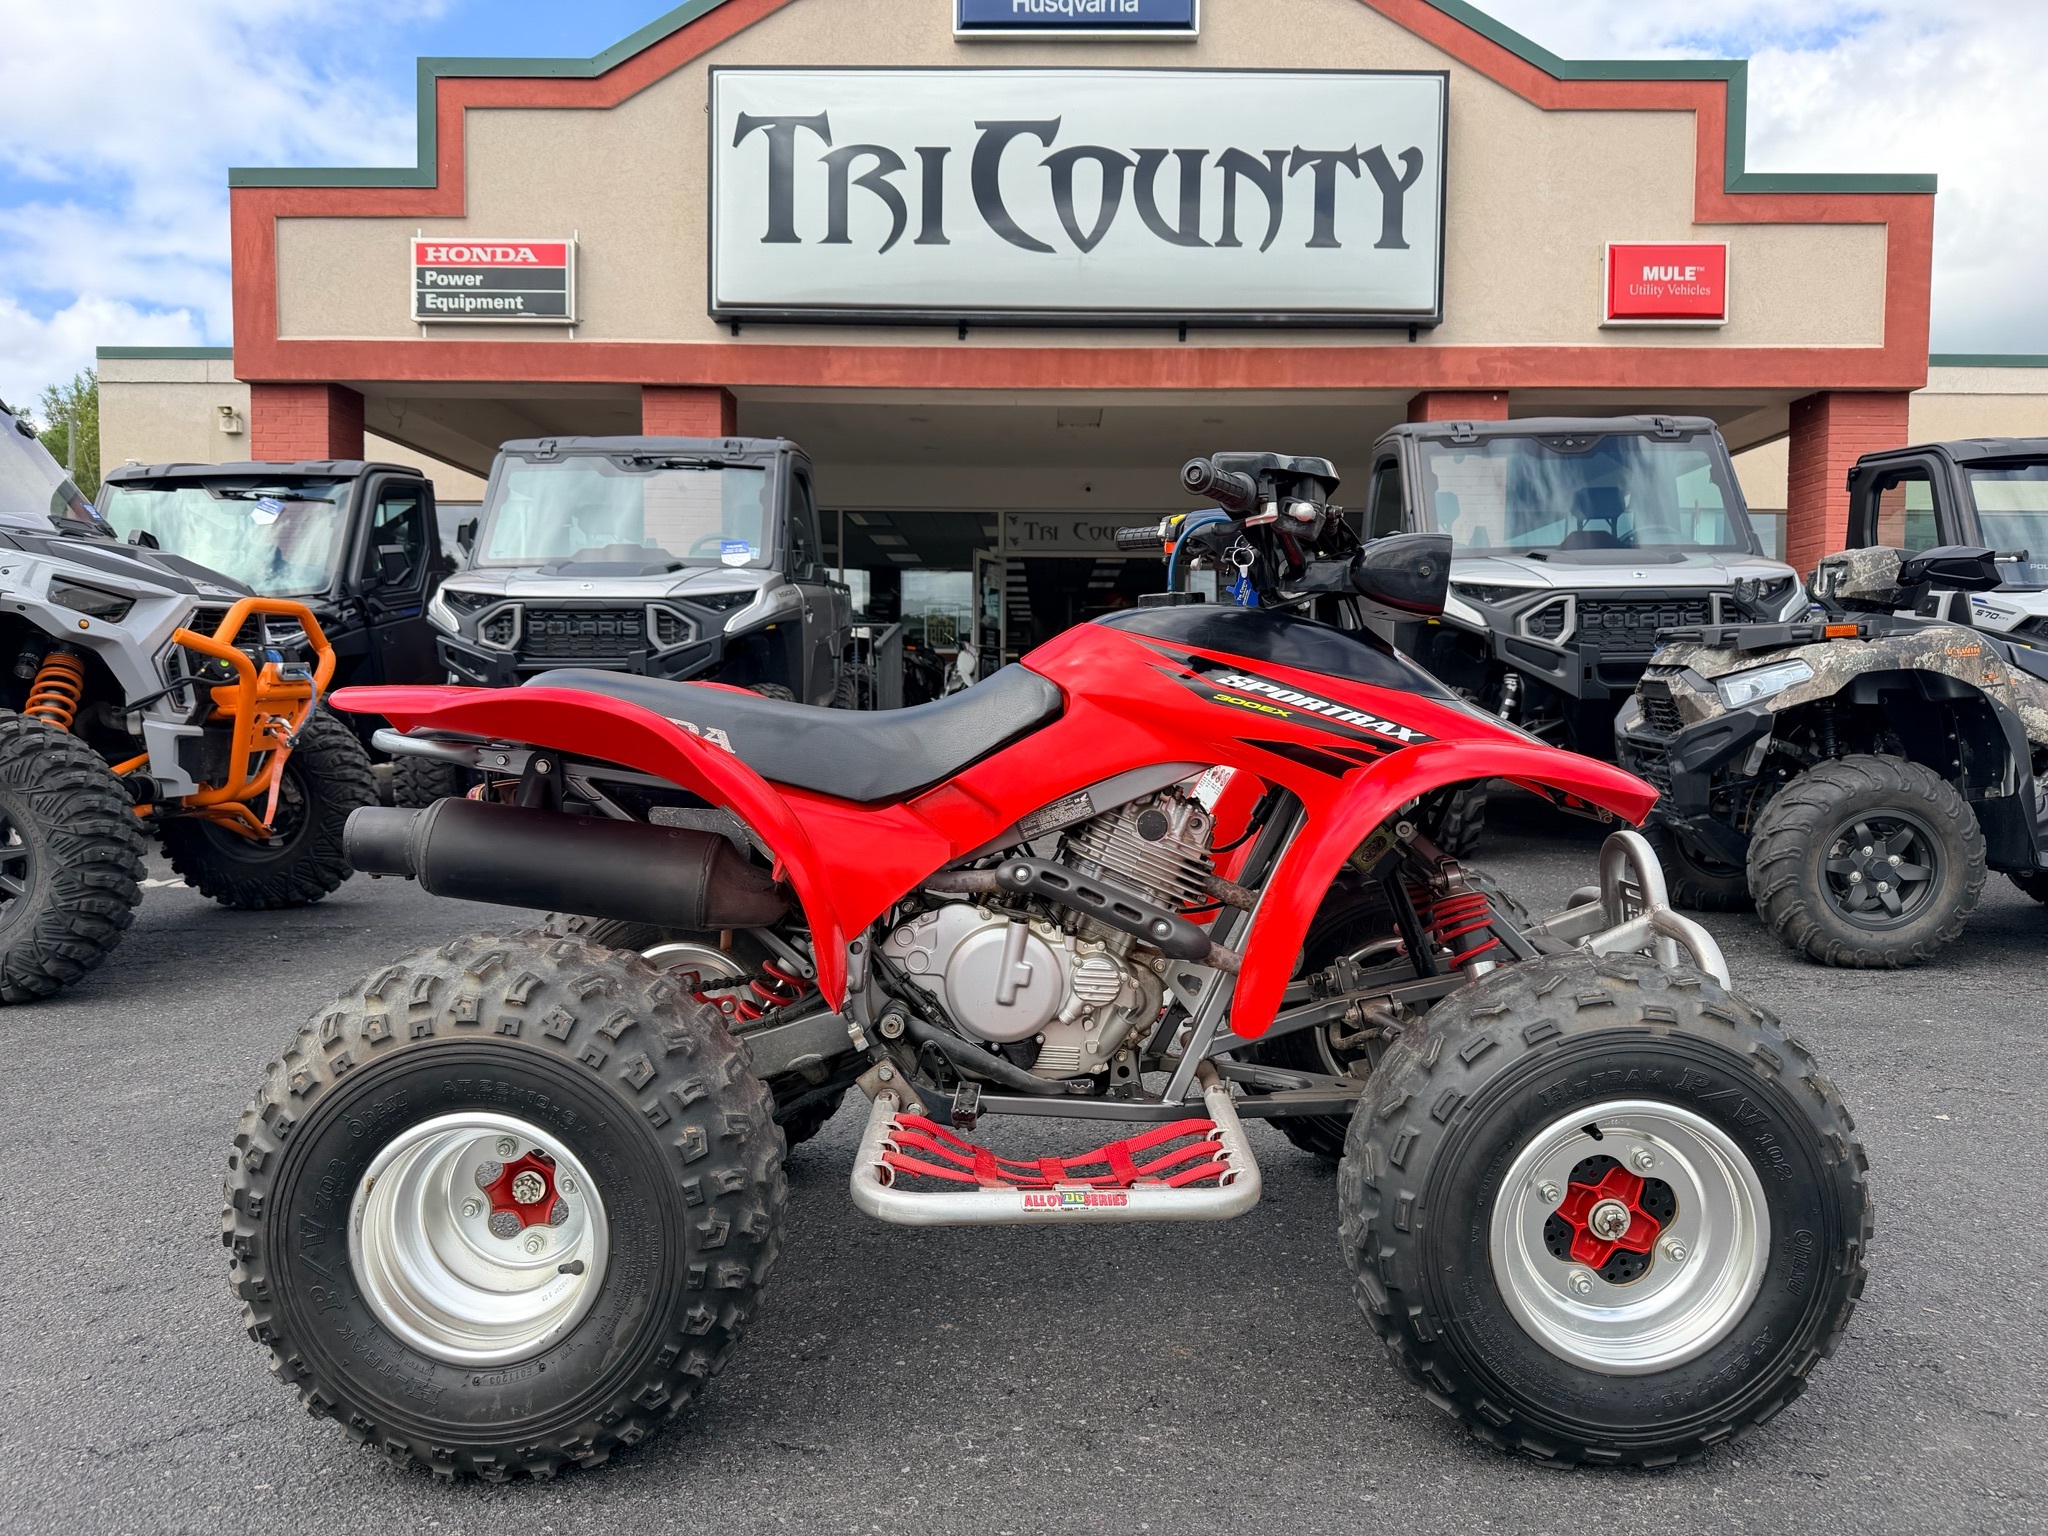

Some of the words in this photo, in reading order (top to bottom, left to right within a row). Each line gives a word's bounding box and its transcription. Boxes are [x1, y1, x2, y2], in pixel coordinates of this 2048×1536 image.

[971, 114, 1424, 255] COUNTY
[424, 247, 540, 263] HONDA
[424, 270, 484, 287] Power
[1628, 284, 1665, 298] Utility
[1667, 284, 1712, 296] Vehicles
[424, 293, 525, 313] Equipment
[528, 620, 640, 635] POLARIS
[1582, 612, 1705, 628] POLARIS
[1213, 693, 1294, 718] 300EX
[1215, 674, 1427, 742] SPORTRAX
[1024, 1195, 1064, 1207] ALLOY
[1084, 1194, 1128, 1207] SERIES
